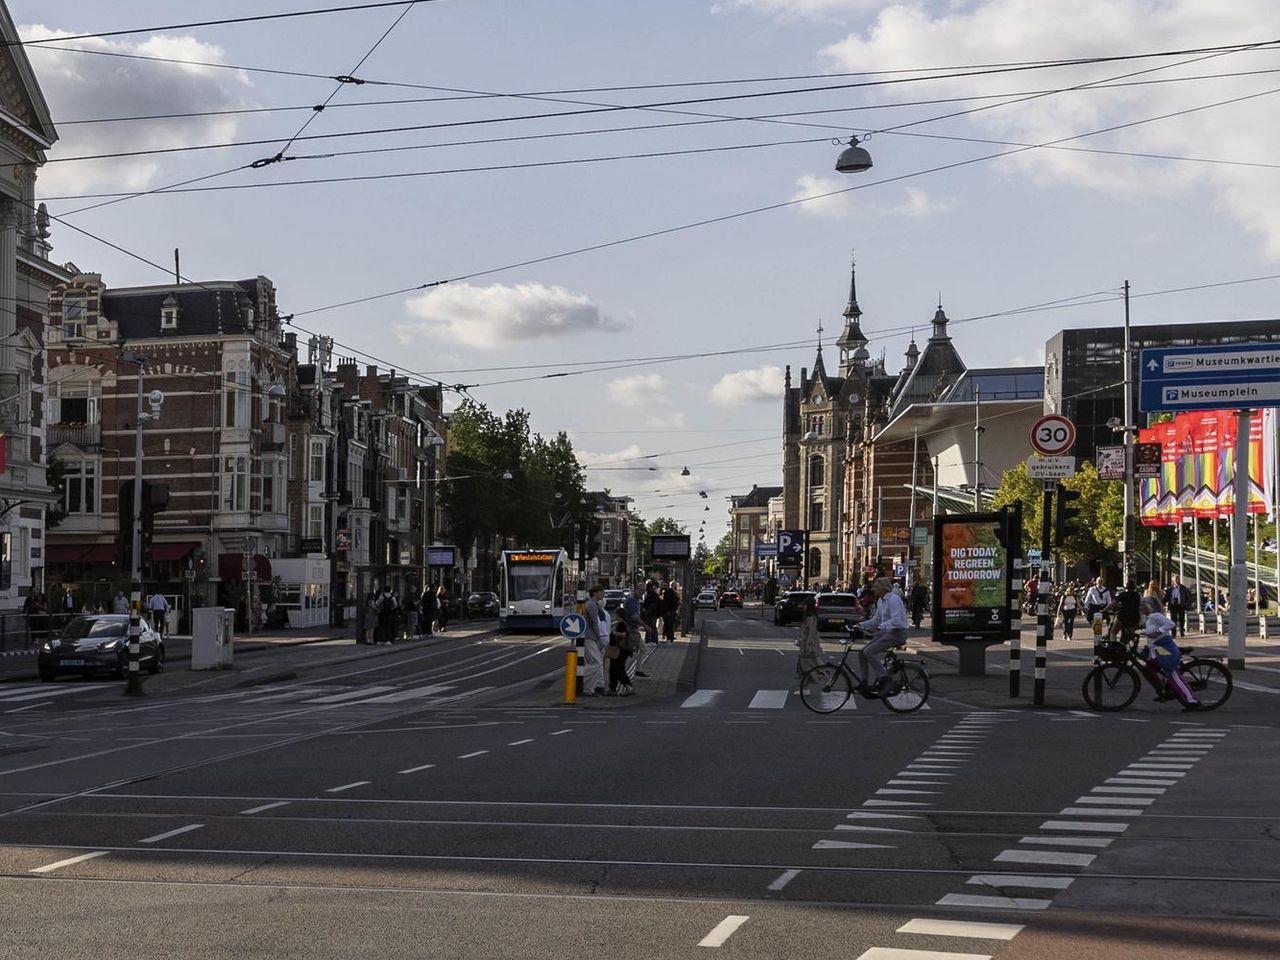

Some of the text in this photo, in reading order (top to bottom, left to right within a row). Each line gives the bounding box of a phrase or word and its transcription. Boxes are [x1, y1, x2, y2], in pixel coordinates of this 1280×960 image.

[1181, 387, 1258, 399] Museumplein
[1040, 427, 1068, 443] 30
[951, 547, 966, 558] DIG
[954, 559, 994, 569] REGREEN
[947, 570, 1001, 580] TOMORROW
